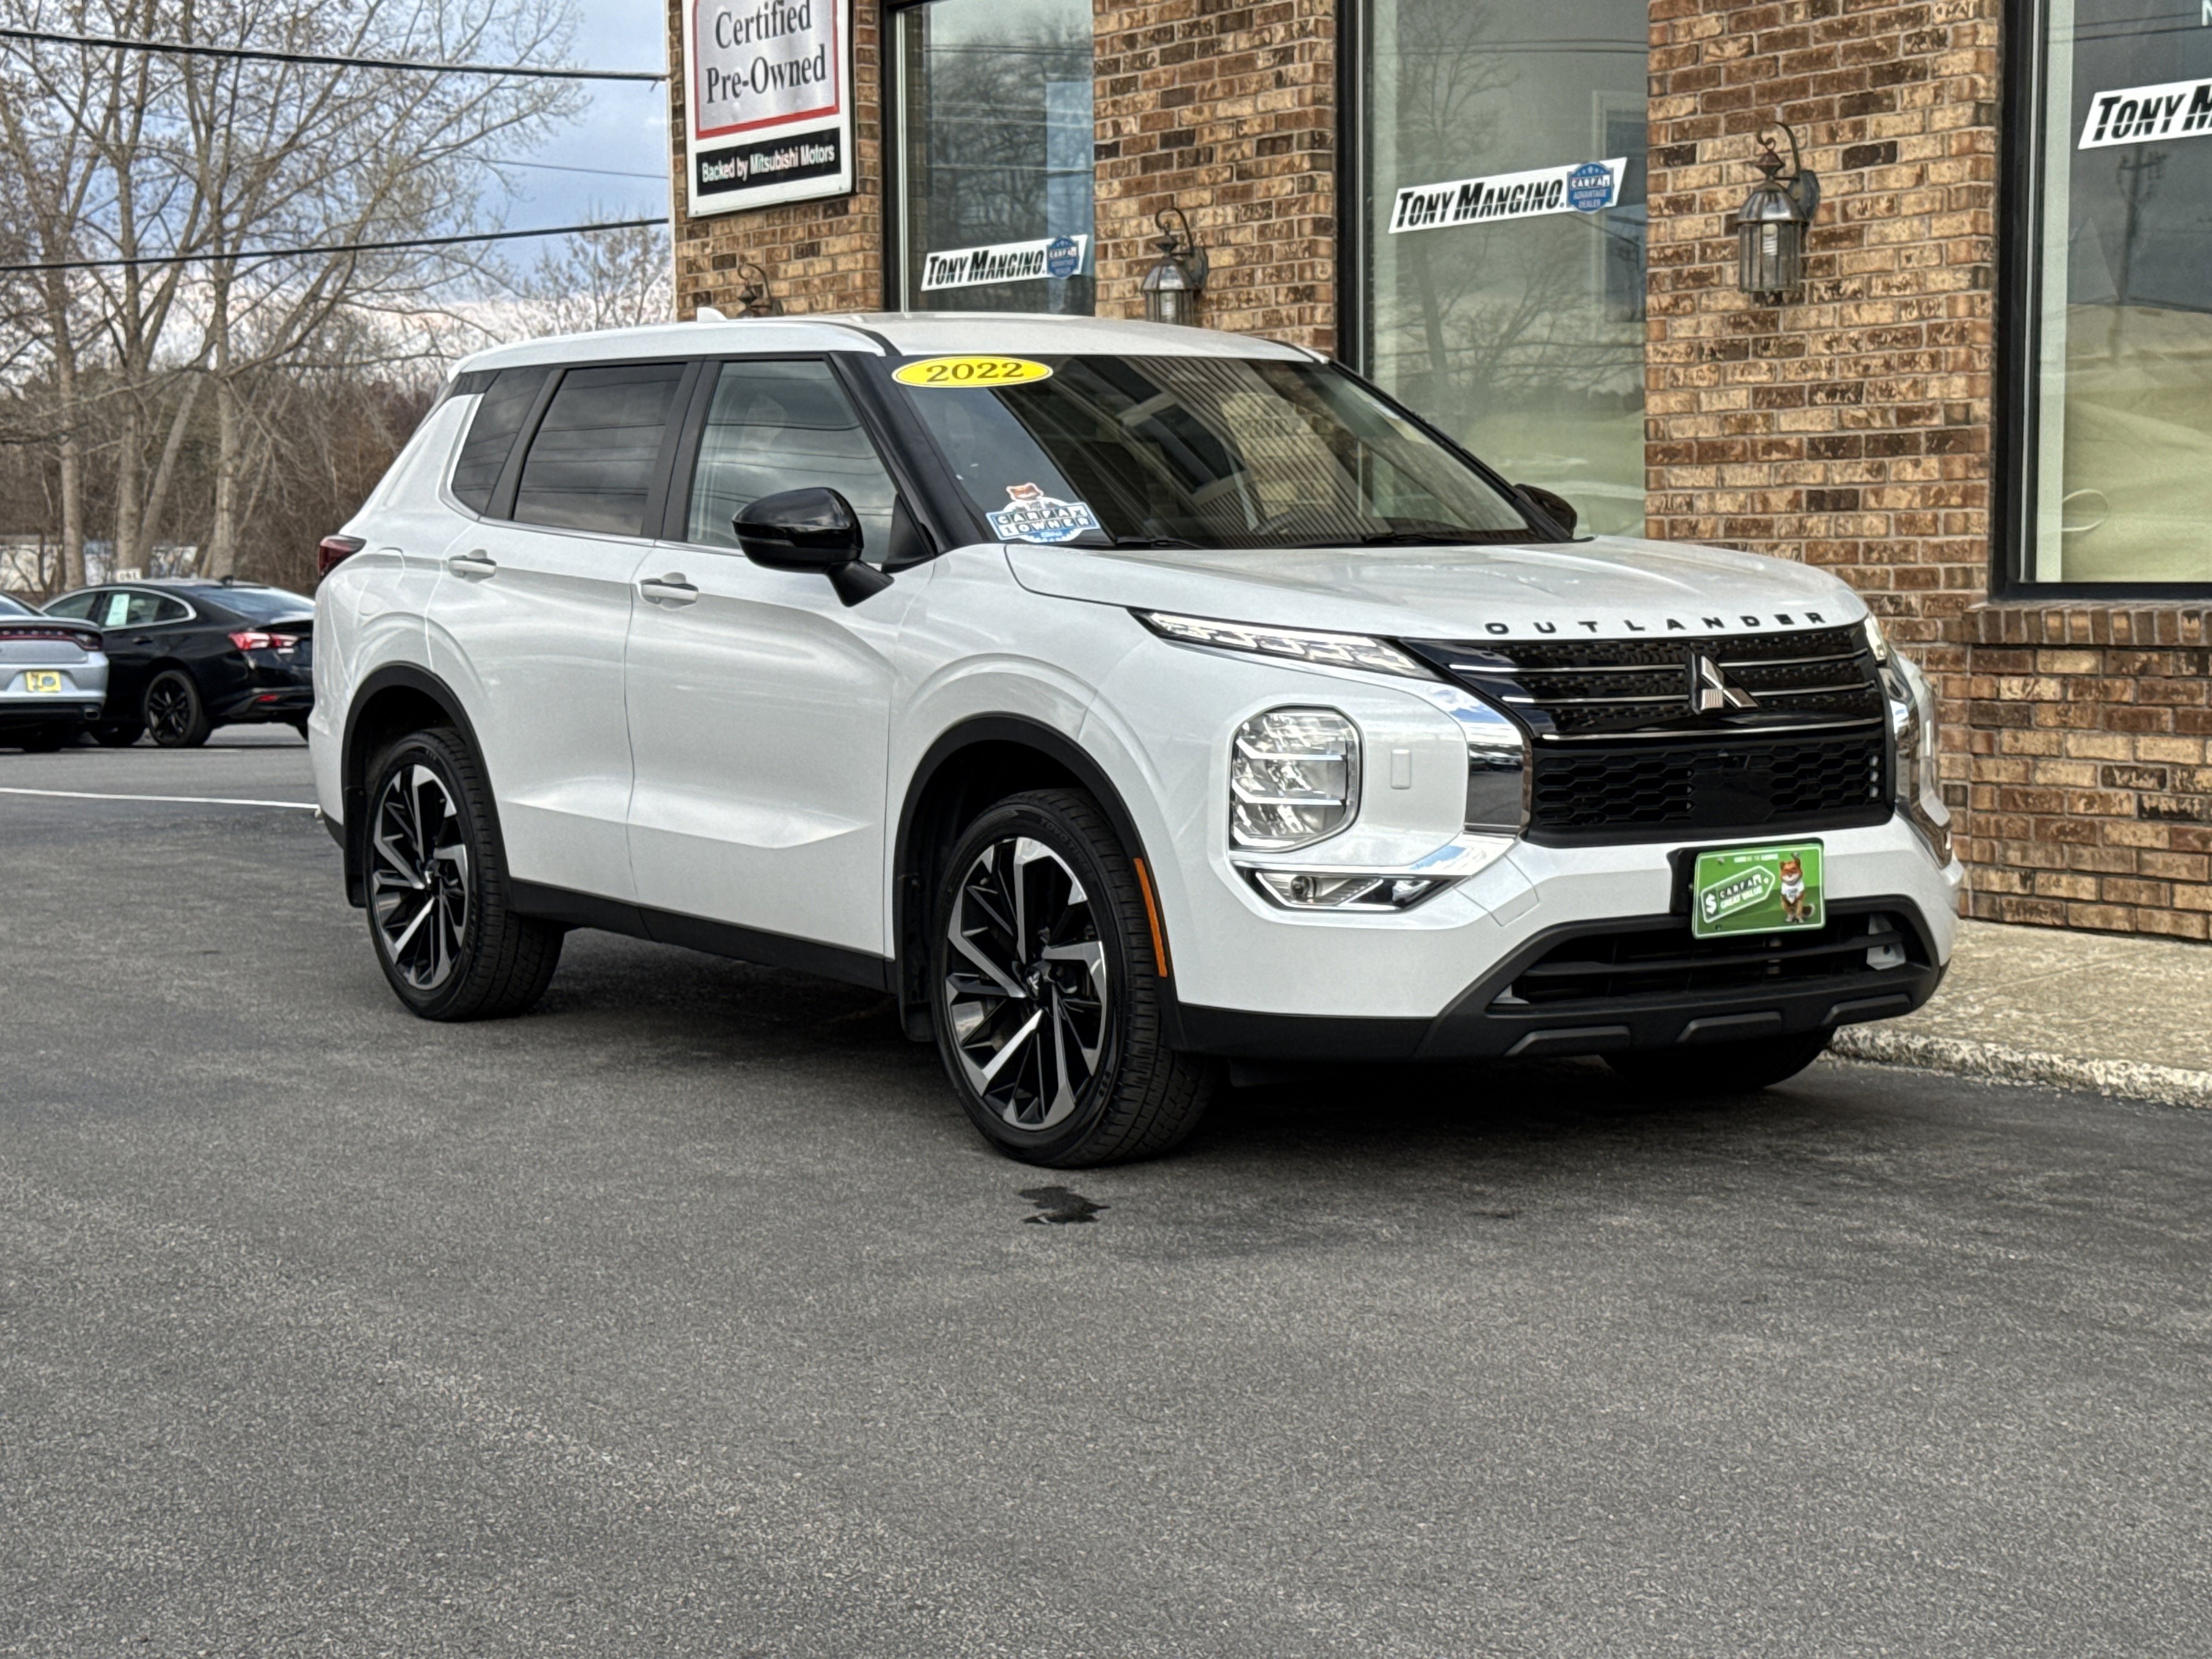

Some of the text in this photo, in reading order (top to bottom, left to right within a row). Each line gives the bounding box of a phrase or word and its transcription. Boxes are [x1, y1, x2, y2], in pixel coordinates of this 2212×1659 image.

[715, 0, 812, 49] Certified
[706, 43, 826, 104] Pre-Owned
[2092, 95, 2187, 142] TONY
[702, 144, 835, 183] Backed by Mitsubishi Motors
[1396, 190, 1455, 229] TONY
[927, 255, 969, 286] TONY
[926, 362, 1024, 383] 2022
[998, 507, 1086, 524] CARFAX
[1018, 518, 1090, 532] OWNER
[1484, 612, 1826, 635] OUTLANDER
